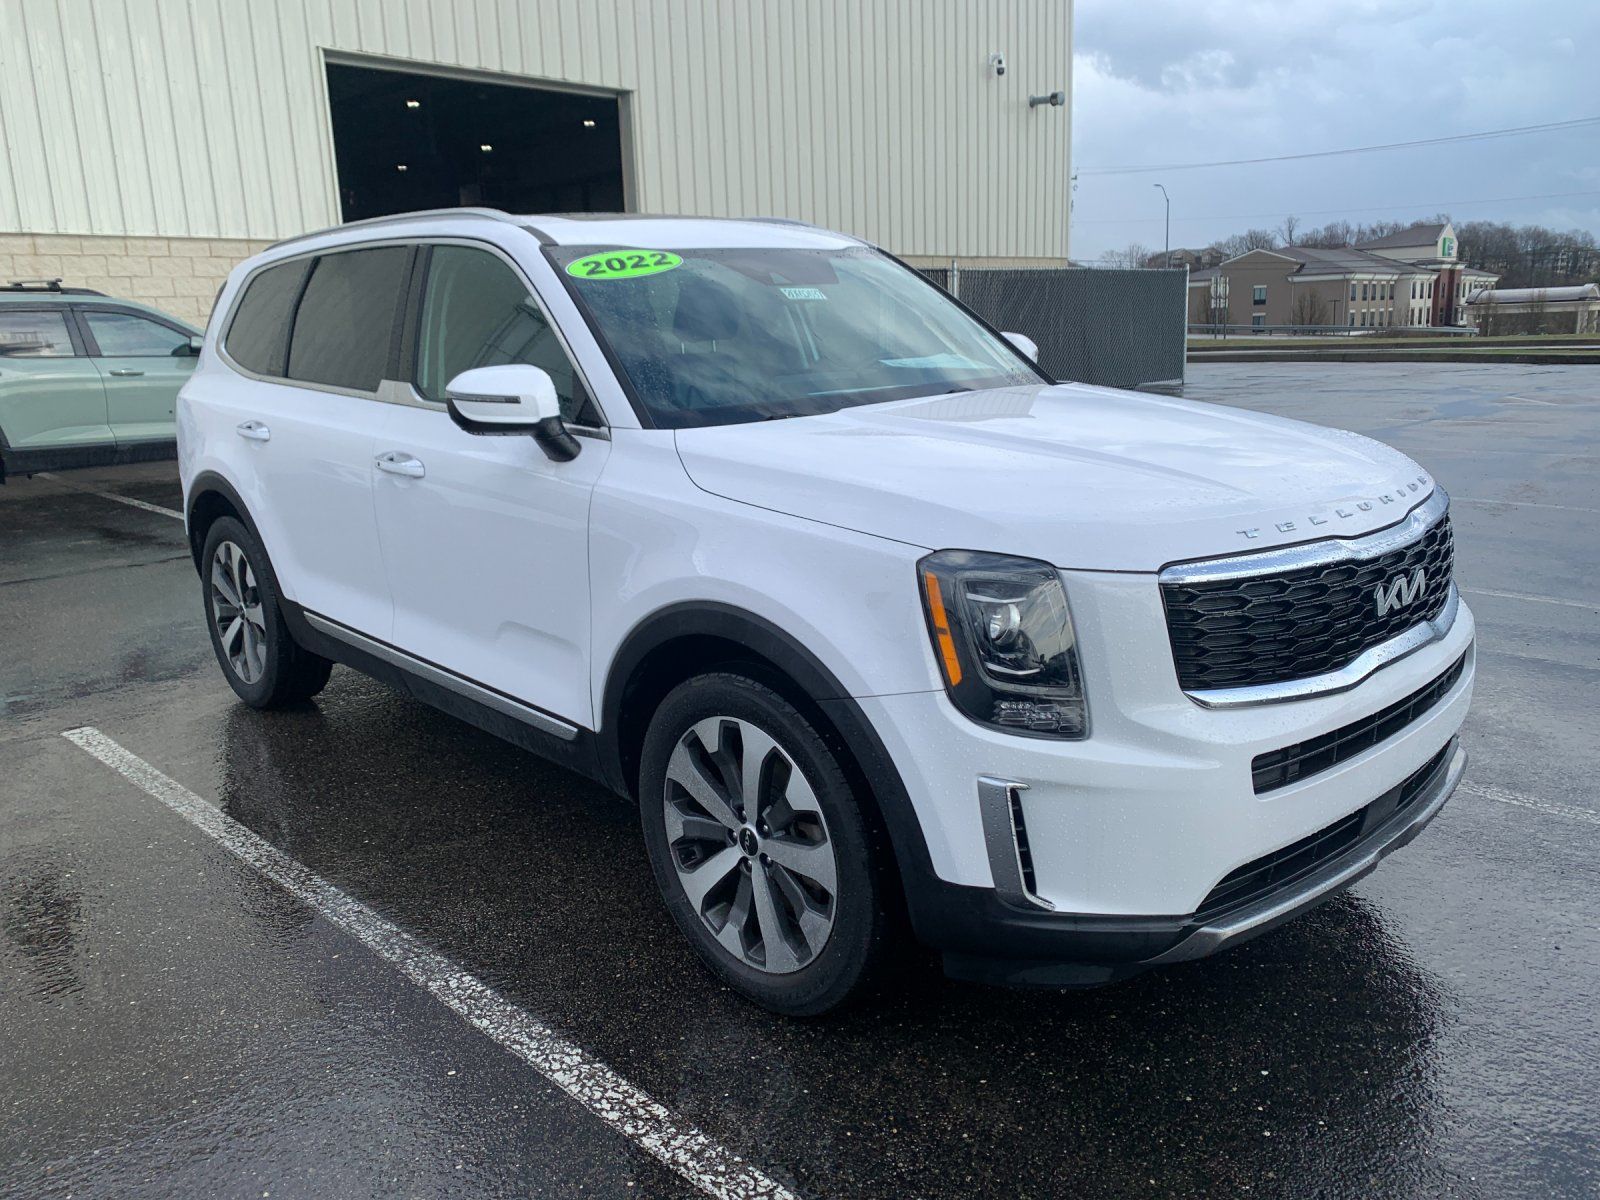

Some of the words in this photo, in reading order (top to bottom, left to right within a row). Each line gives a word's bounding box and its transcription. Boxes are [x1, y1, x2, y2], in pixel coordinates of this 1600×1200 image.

[582, 252, 673, 276] 2022
[1236, 475, 1428, 538] TELLURIDE
[1376, 569, 1426, 617] KIA
